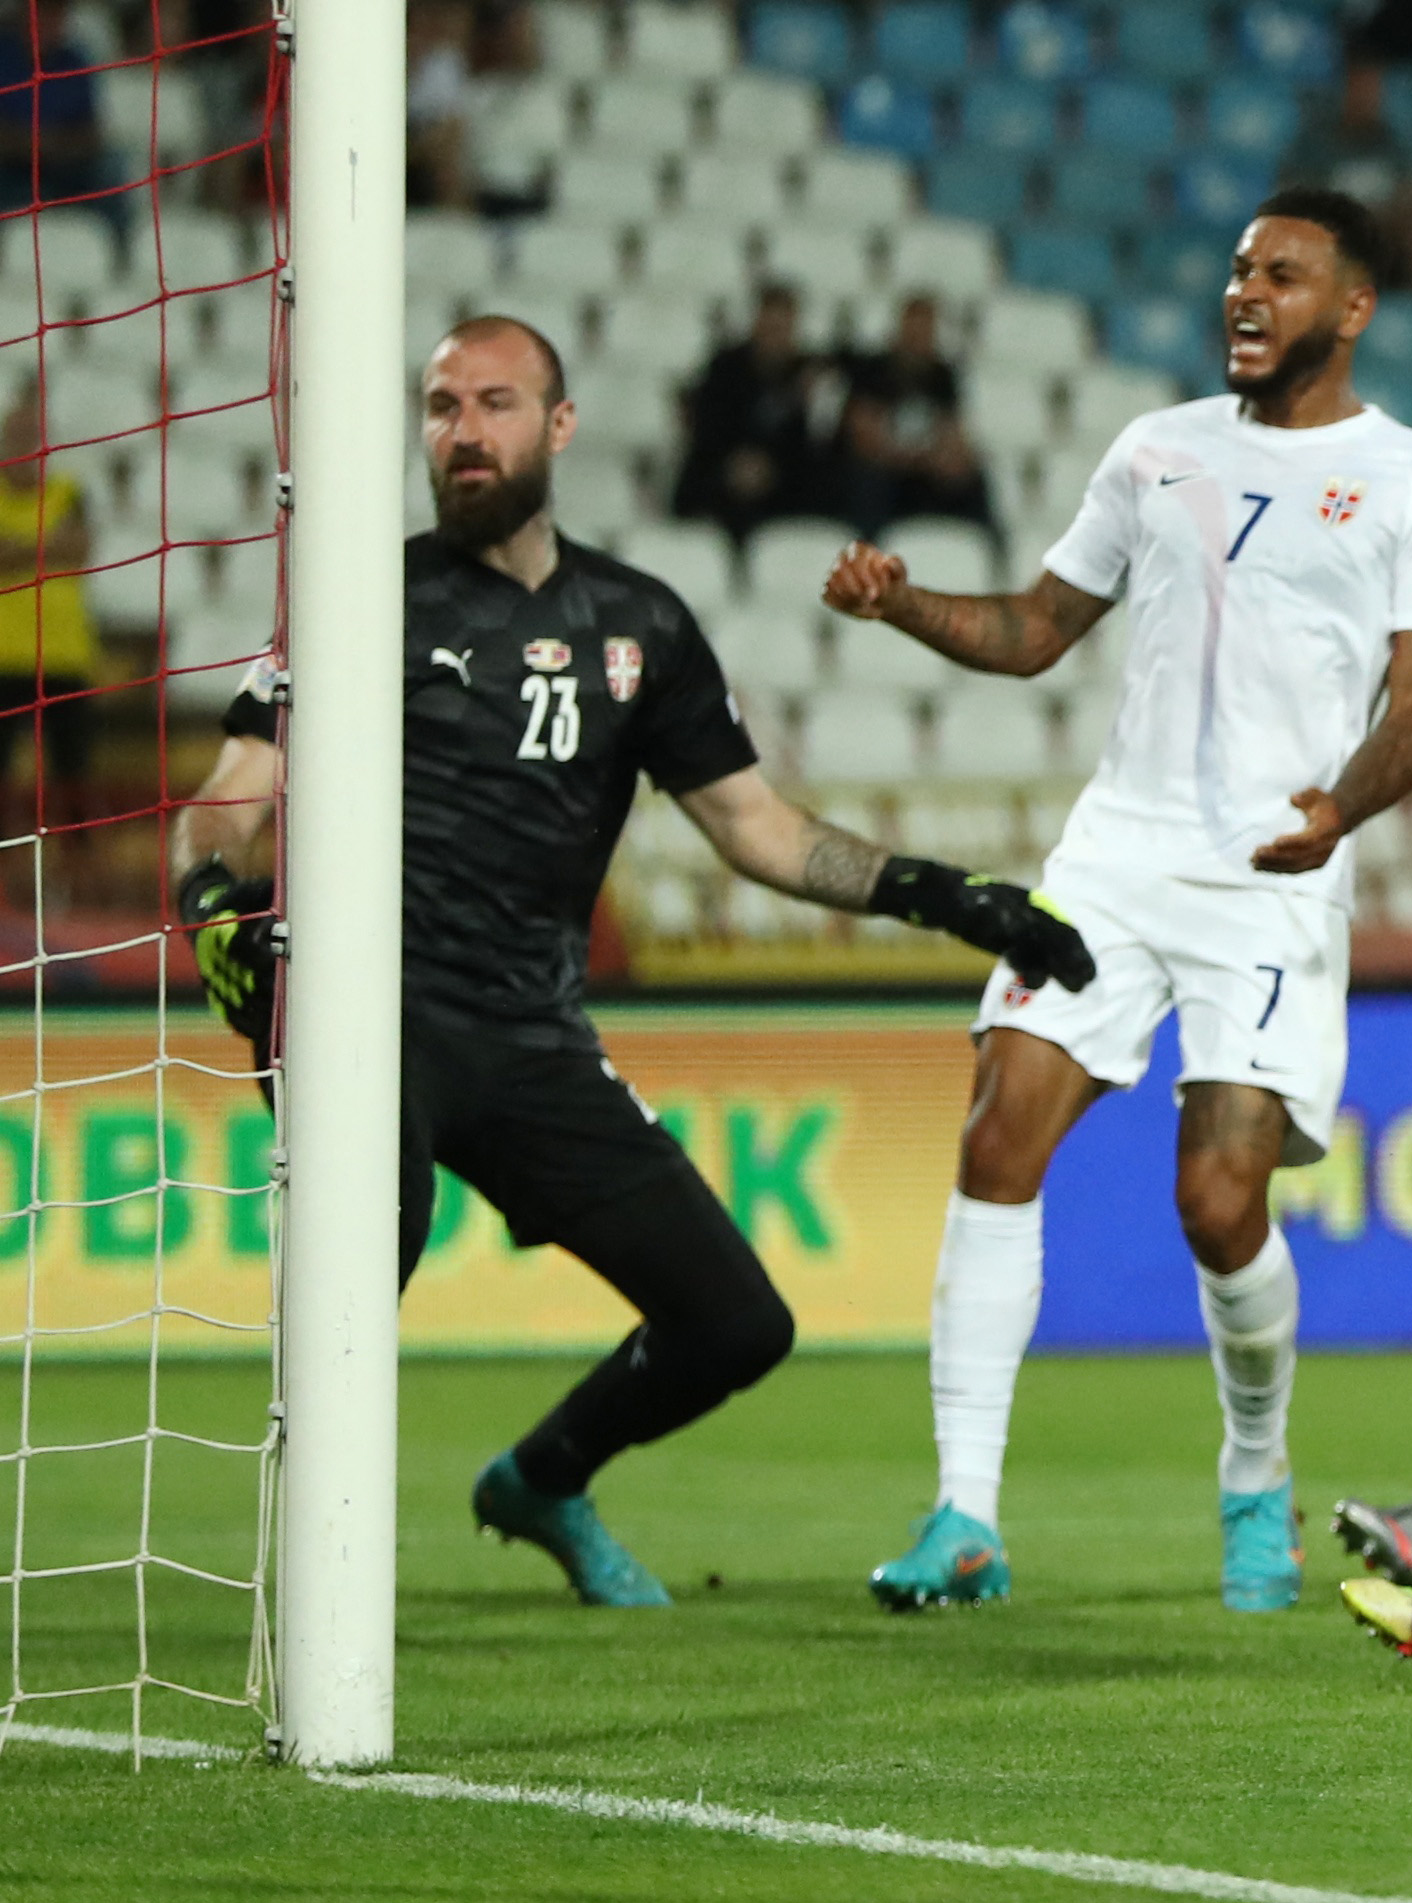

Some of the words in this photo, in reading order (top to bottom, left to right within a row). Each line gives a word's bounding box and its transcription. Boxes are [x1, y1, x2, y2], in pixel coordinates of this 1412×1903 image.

[1225, 492, 1274, 563] 7
[516, 674, 581, 763] 23
[1256, 964, 1284, 1030] 7
